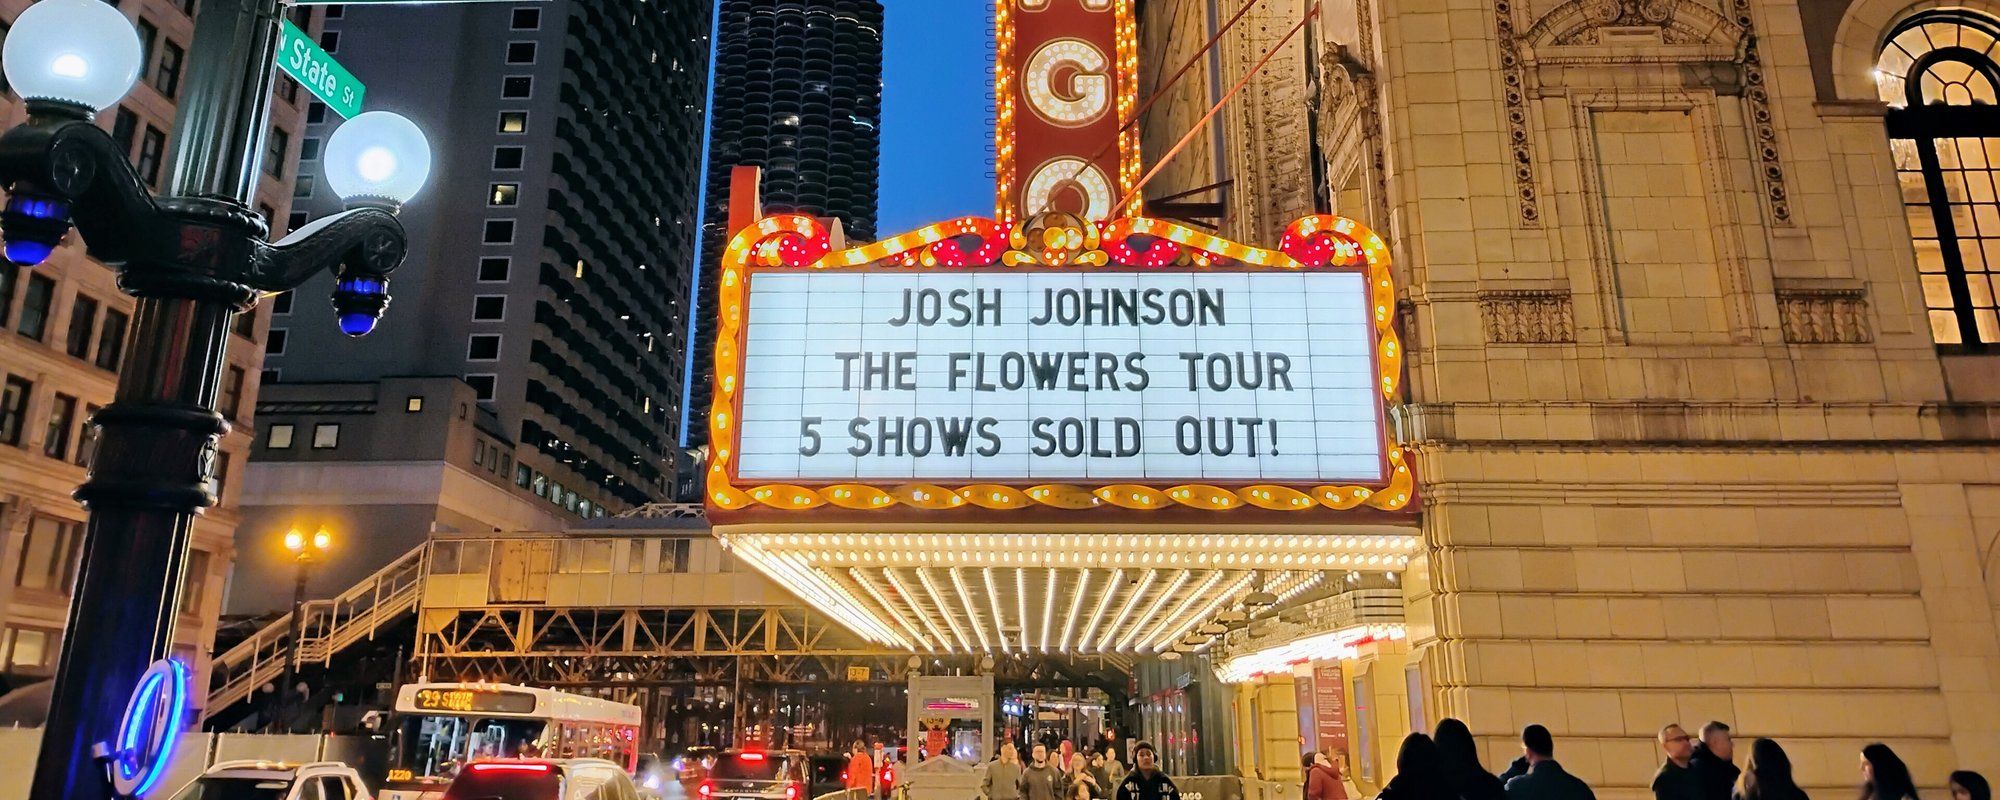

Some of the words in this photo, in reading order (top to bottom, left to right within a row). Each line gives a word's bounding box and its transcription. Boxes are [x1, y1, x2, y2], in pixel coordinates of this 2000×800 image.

[290, 38, 336, 98] State
[342, 85, 354, 108] St
[1020, 0, 1116, 222] GO
[888, 288, 1001, 327] JOSH
[1030, 287, 1225, 327] JOHNSON
[834, 351, 917, 392] THE
[949, 351, 1150, 392] FLOWERS
[1179, 351, 1294, 392] TOUR
[798, 416, 822, 458] 5
[847, 416, 1001, 458] SHOWS
[1031, 416, 1141, 458] SOLD
[1175, 415, 1279, 458] OUT!
[422, 689, 441, 707] 29
[388, 769, 412, 781] 1220
